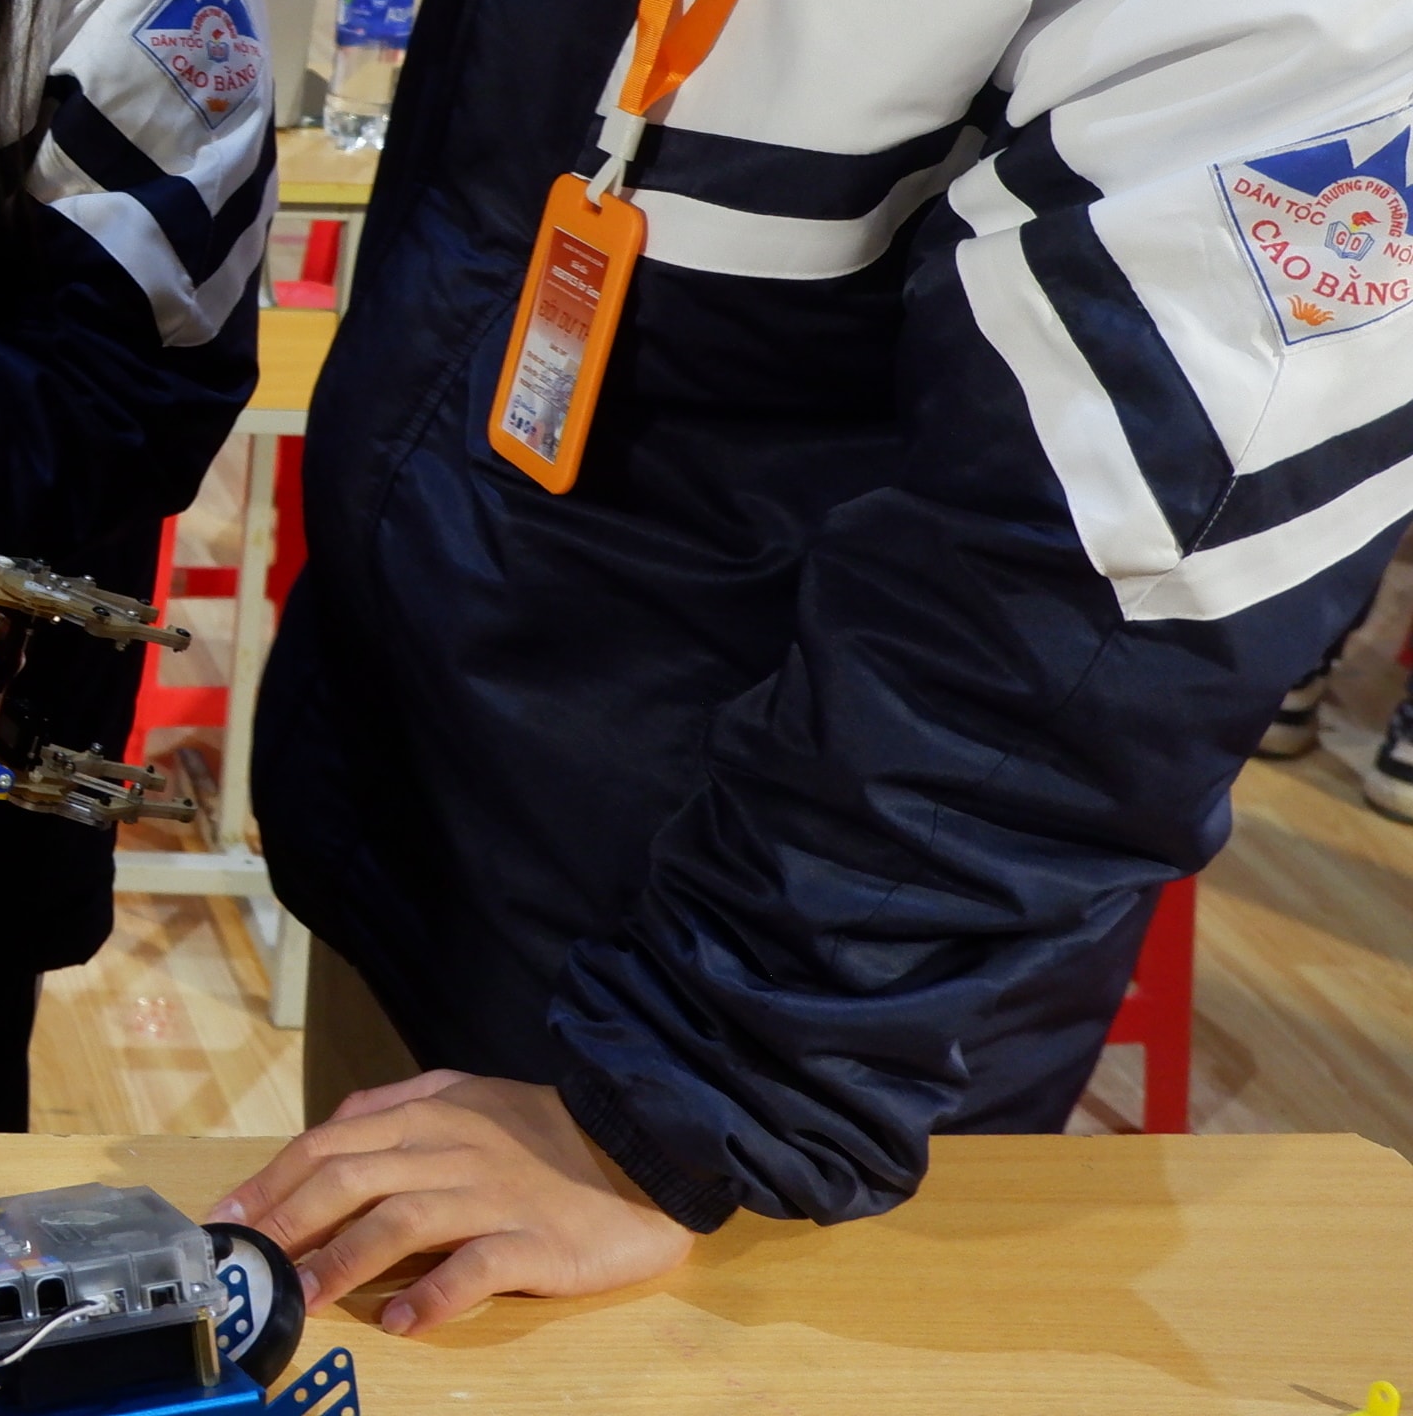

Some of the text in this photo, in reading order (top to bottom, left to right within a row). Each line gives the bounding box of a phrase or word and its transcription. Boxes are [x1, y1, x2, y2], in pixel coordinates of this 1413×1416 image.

[150, 34, 177, 47] DÂN
[179, 35, 204, 52] TỘC
[172, 55, 256, 92] CAO BẰNG
[1233, 177, 1281, 208] DÂN
[1284, 199, 1326, 226] TỘC
[1315, 179, 1407, 238] TRƯỜNG PHỔ THÔNG
[1252, 219, 1410, 306] CAO BẰNG
